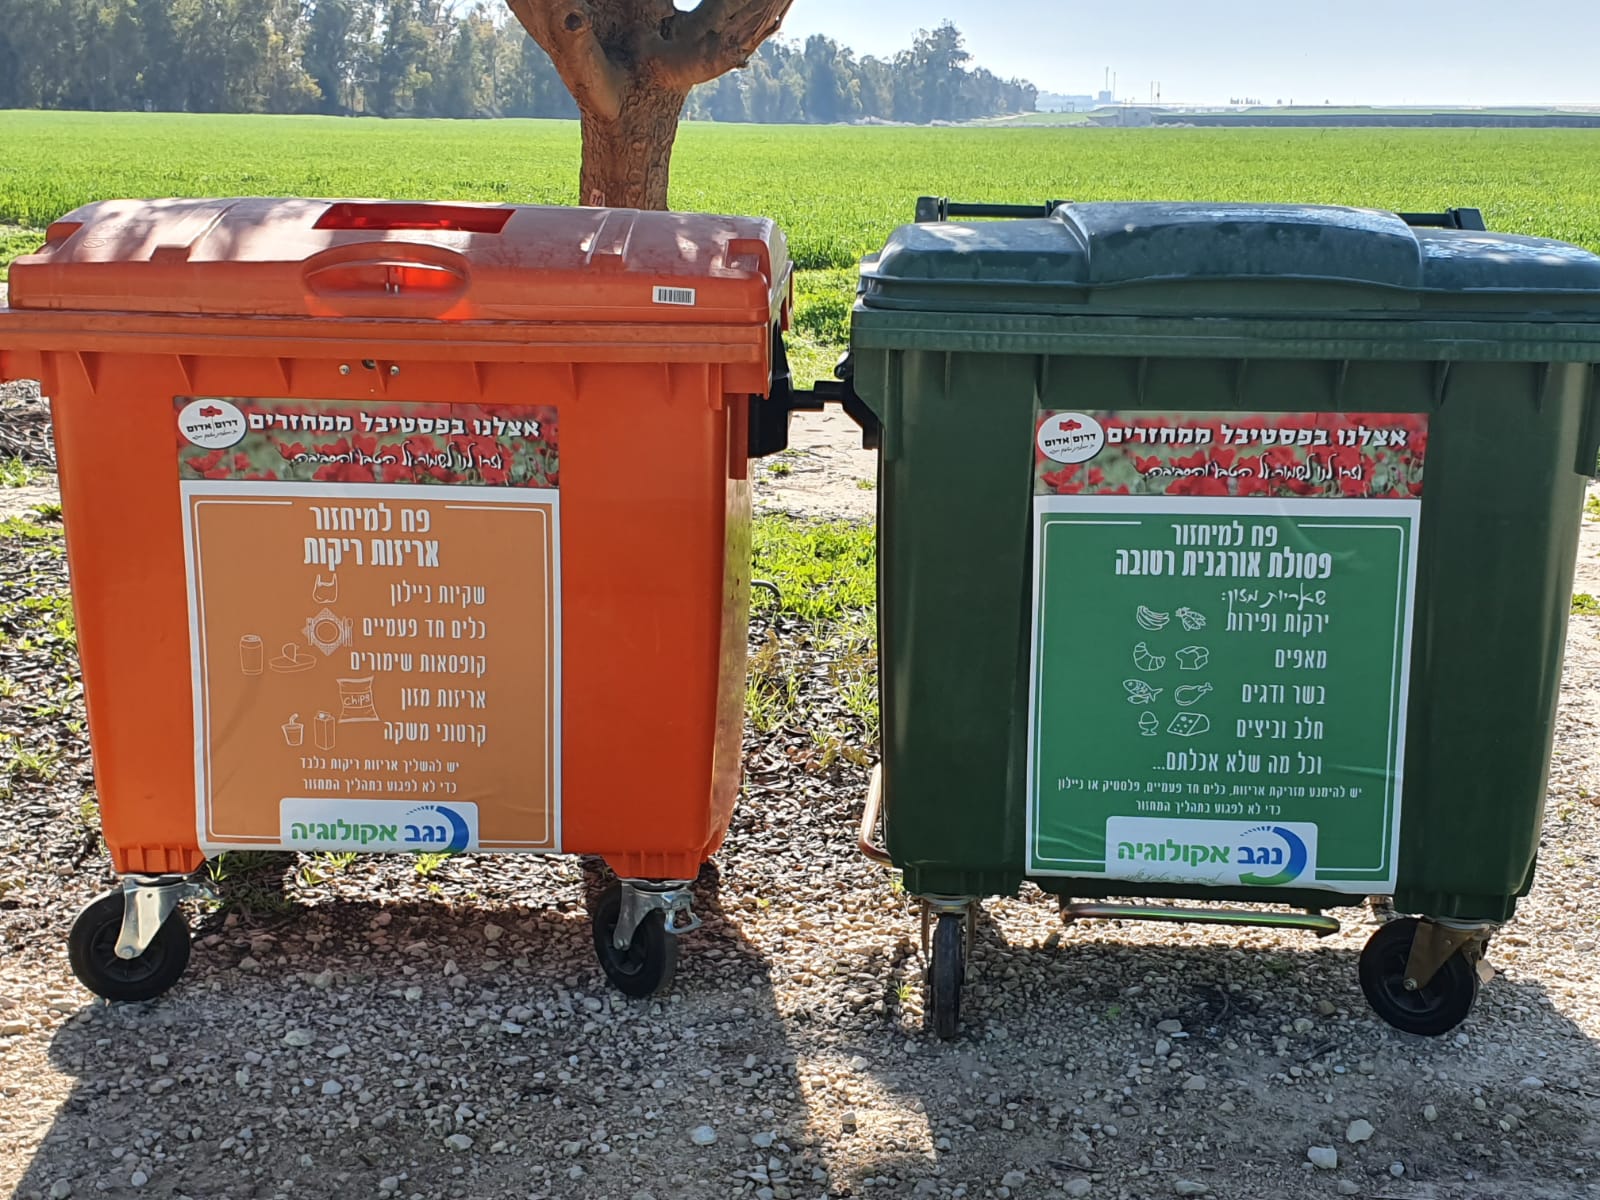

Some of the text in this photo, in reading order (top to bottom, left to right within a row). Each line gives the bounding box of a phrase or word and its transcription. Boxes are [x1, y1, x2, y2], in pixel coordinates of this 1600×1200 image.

[186, 419, 237, 432] דרום אדום
[249, 412, 540, 437] אצלנו בפסטיבל ממחזרים
[1107, 424, 1407, 447] אצלנו בפסטיבל ממחזרים
[1044, 433, 1096, 447] דרום אדום
[309, 502, 431, 532] פח למיחזור
[1171, 520, 1278, 547] פח למיחזור
[304, 537, 439, 571] אריזות ריקות
[1115, 546, 1332, 579] פסולת אורגנית רטובה
[390, 580, 486, 608] שקיות ניילון
[1221, 582, 1326, 614] שאריות מזון:
[363, 616, 486, 639] כלים חד פעמיים
[1225, 612, 1329, 637] ירקות ופירות
[351, 652, 486, 678] קופסאות שימורים
[1275, 649, 1327, 669] מאפים
[401, 688, 486, 711] אריזות מזון
[1242, 684, 1325, 705] בשר ודגים
[384, 722, 486, 747] קרטוני משקה
[1236, 716, 1323, 739] חלב וביצים
[300, 756, 459, 773] יש להשליך אריזות ריקות בלבד
[1152, 748, 1322, 775] וכל מה שלא אכלתם...
[303, 778, 457, 793] כדי לא לפגוע בתהליך המחזור
[1058, 776, 1084, 791] ניילון
[1088, 780, 1098, 791] או
[1103, 779, 1140, 792] פלסטיק
[1187, 783, 1199, 794] חד
[1203, 782, 1226, 795] כלים
[1269, 785, 1305, 799] מזריקת
[1309, 785, 1346, 798] להימנע
[1350, 787, 1362, 798] יש
[1136, 800, 1281, 816] כדי לא לפגוע בתהליך המחזור
[291, 819, 447, 845] נגב אקולוגיה
[1118, 838, 1283, 867] נגב אקולוגיה
